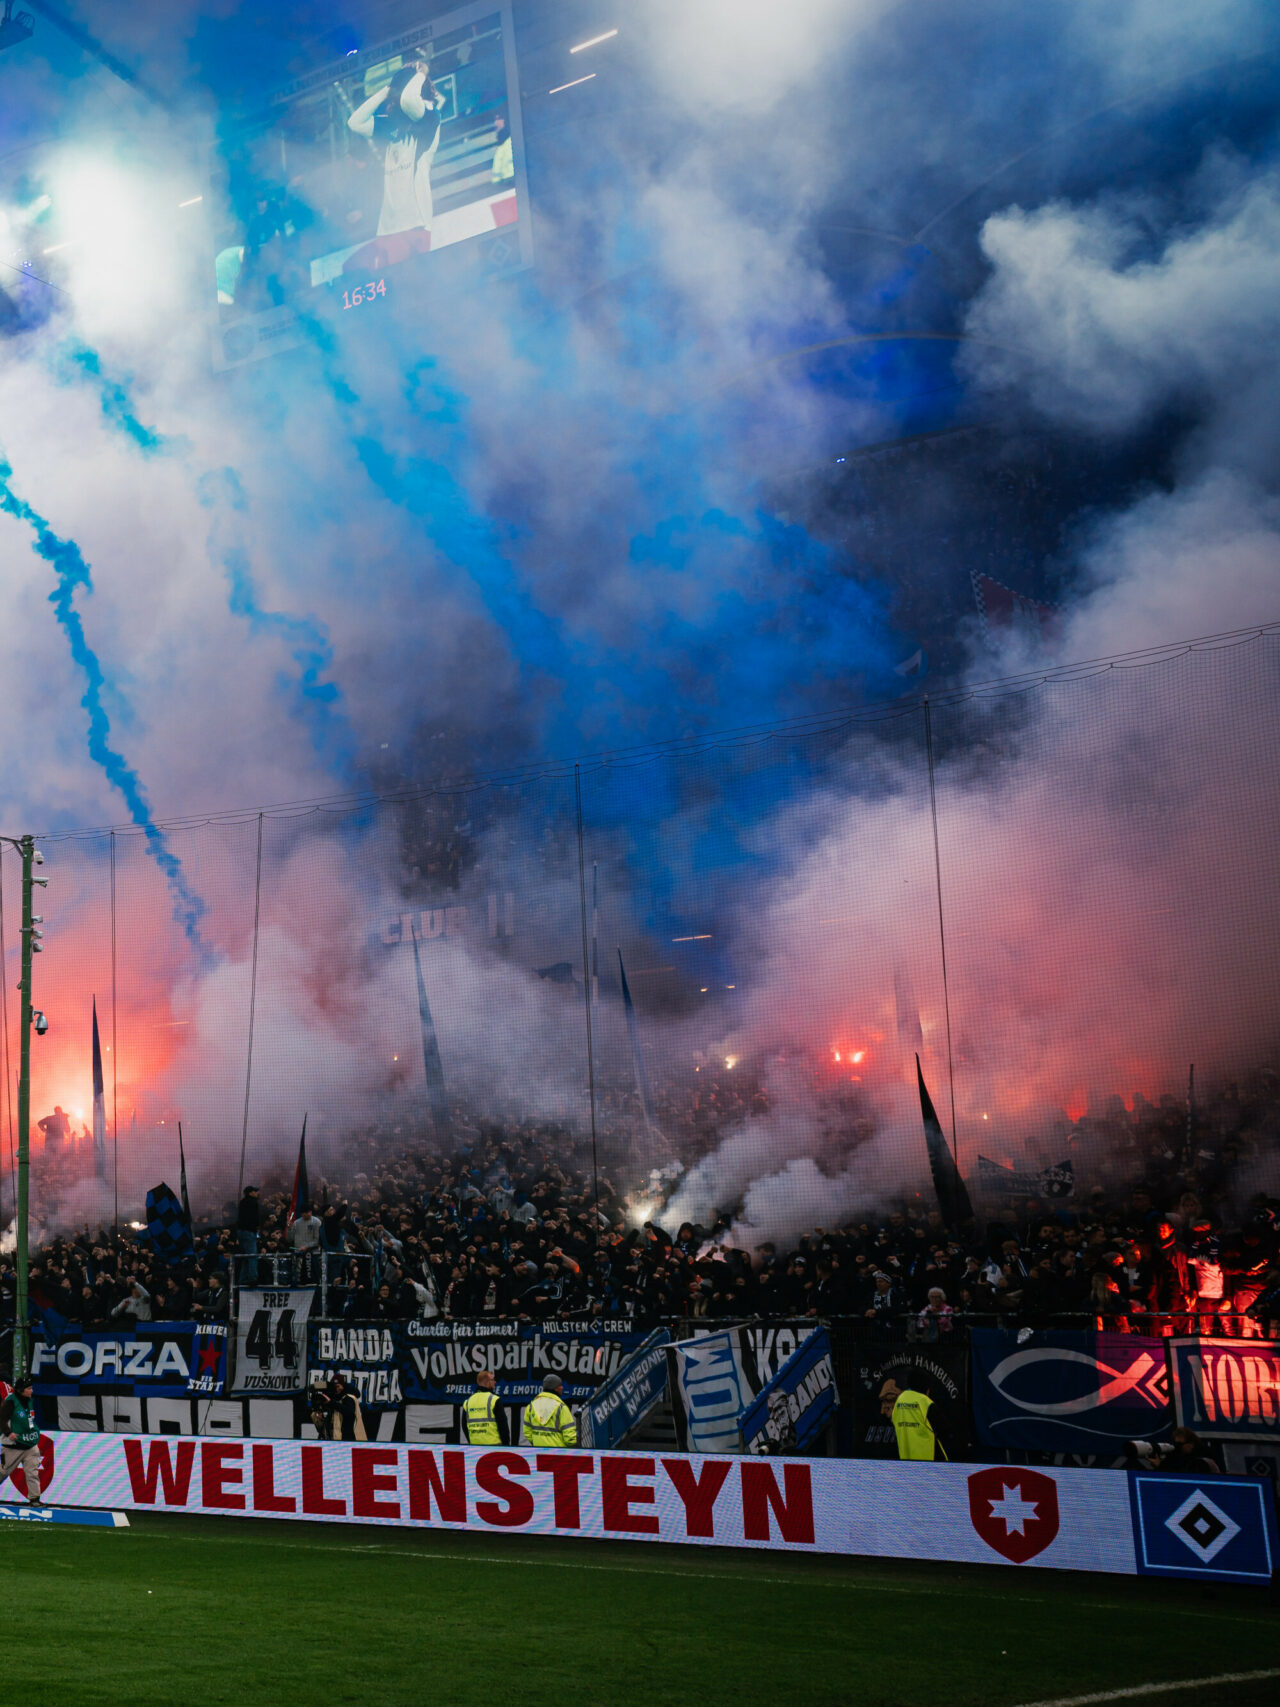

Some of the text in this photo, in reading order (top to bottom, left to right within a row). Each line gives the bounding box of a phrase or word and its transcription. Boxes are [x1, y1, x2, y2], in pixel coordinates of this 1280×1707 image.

[341, 278, 387, 310] 16:34
[262, 1292, 290, 1308] FREE
[246, 1308, 299, 1370] 44
[407, 1320, 519, 1340] Charlie für immer!
[542, 1320, 632, 1334] HOLSTEN CREW
[30, 1341, 190, 1377] FORZA
[319, 1327, 394, 1363] BANDA
[571, 1386, 591, 1397] SEIT
[915, 1354, 959, 1400] HAMBURG
[122, 1439, 816, 1544] WELLENSTEYN
